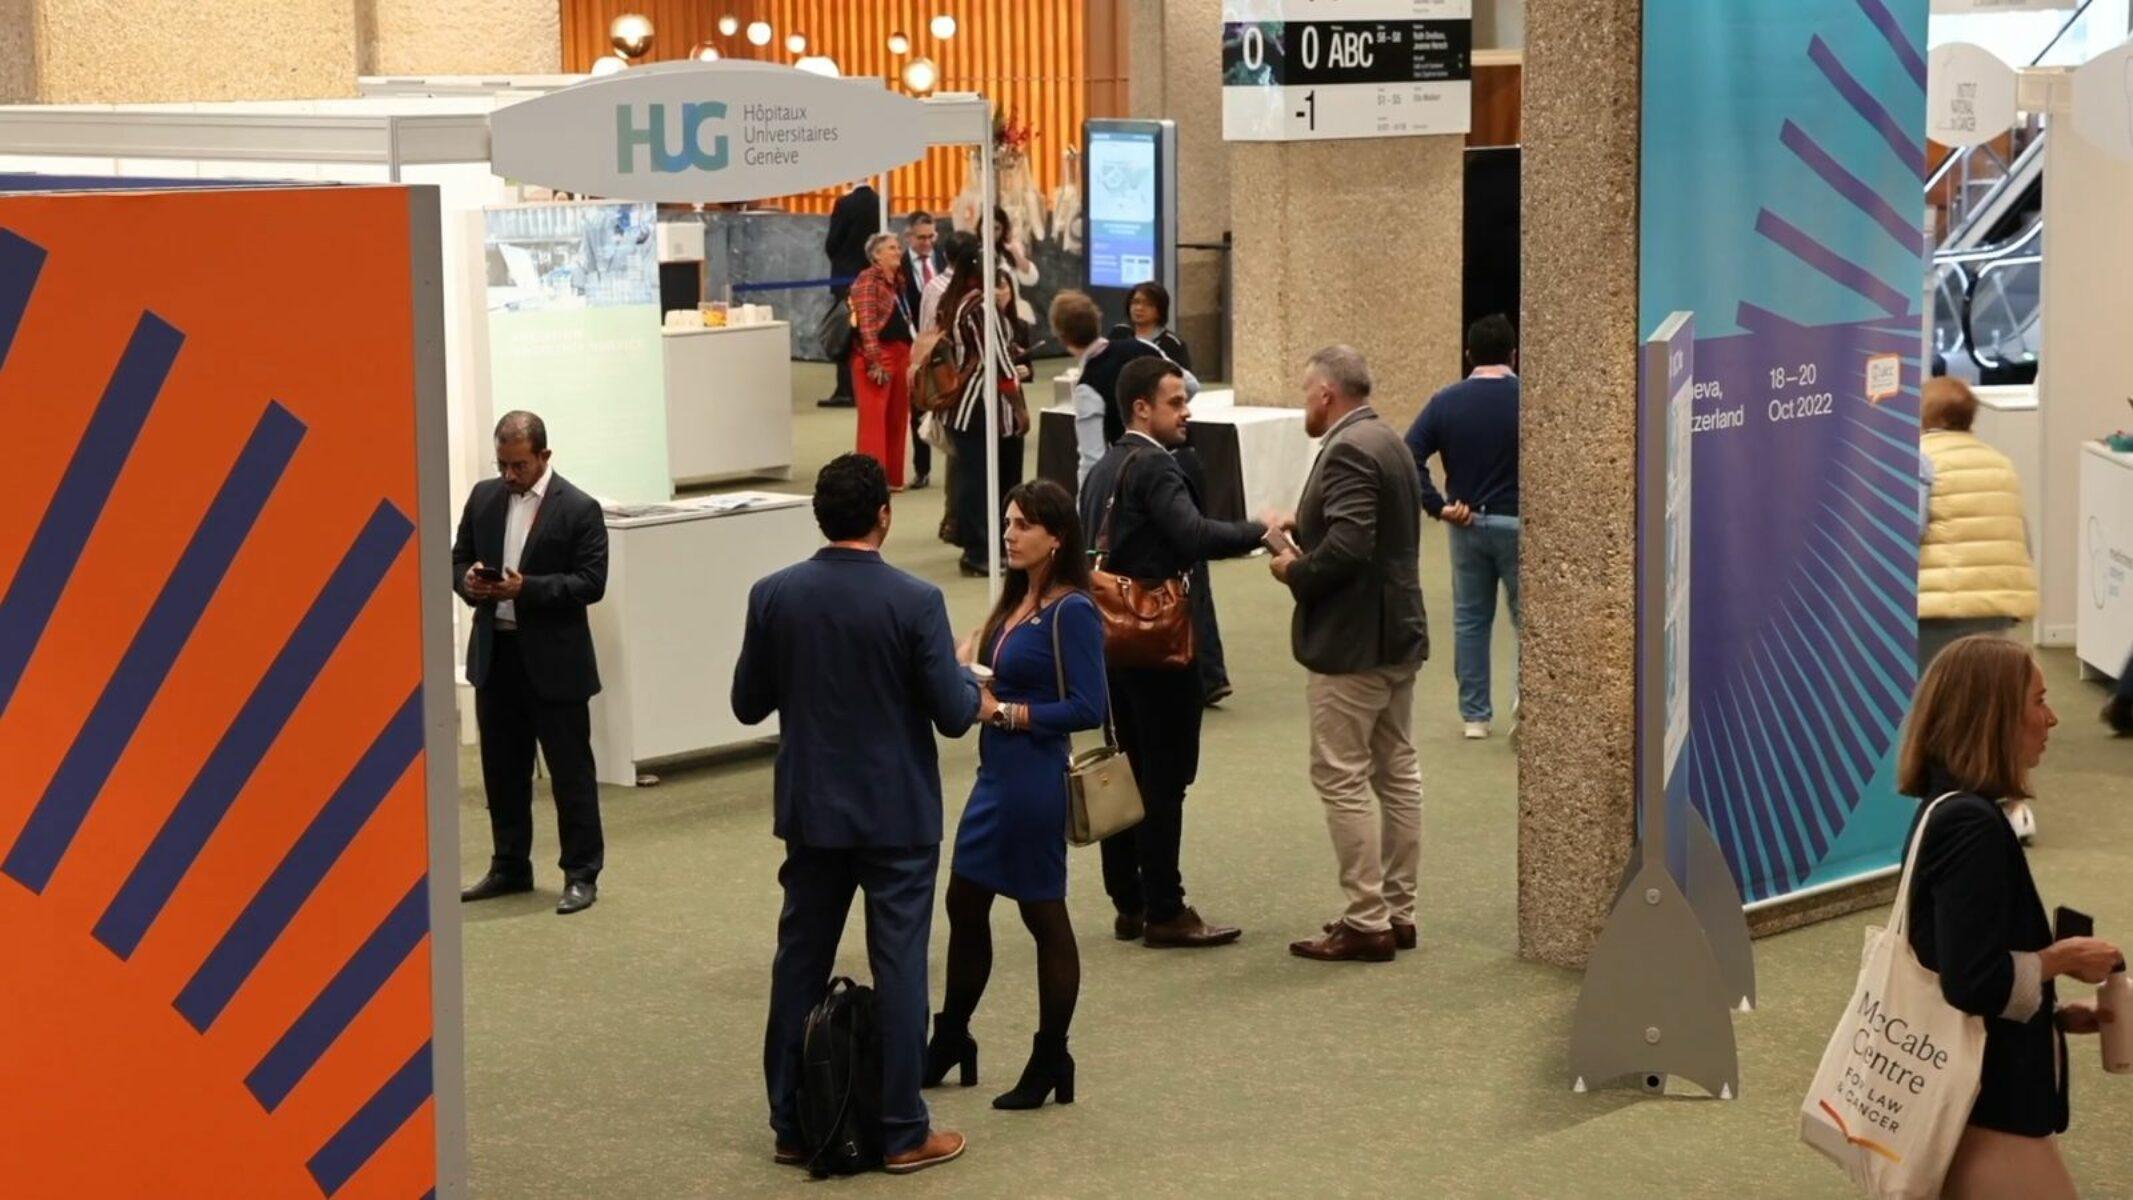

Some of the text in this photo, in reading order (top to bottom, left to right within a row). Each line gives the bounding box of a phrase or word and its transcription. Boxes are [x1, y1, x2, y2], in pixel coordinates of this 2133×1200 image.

[1242, 26, 1264, 70] 0
[1301, 25, 1374, 70] 0 ABC
[743, 104, 807, 122] Hôpitaux
[1295, 89, 1315, 131] -1
[616, 101, 729, 173] HUG
[744, 125, 838, 143] Universitaires
[744, 147, 799, 166] Genève
[1692, 381, 1723, 400] eva,
[1768, 392, 1832, 421] Oct 2022
[1857, 991, 1948, 1070] McCabe
[1852, 1028, 1925, 1095] Centre
[1845, 1090, 1900, 1134] CANCER
[1867, 1088, 1903, 1114] LAW
